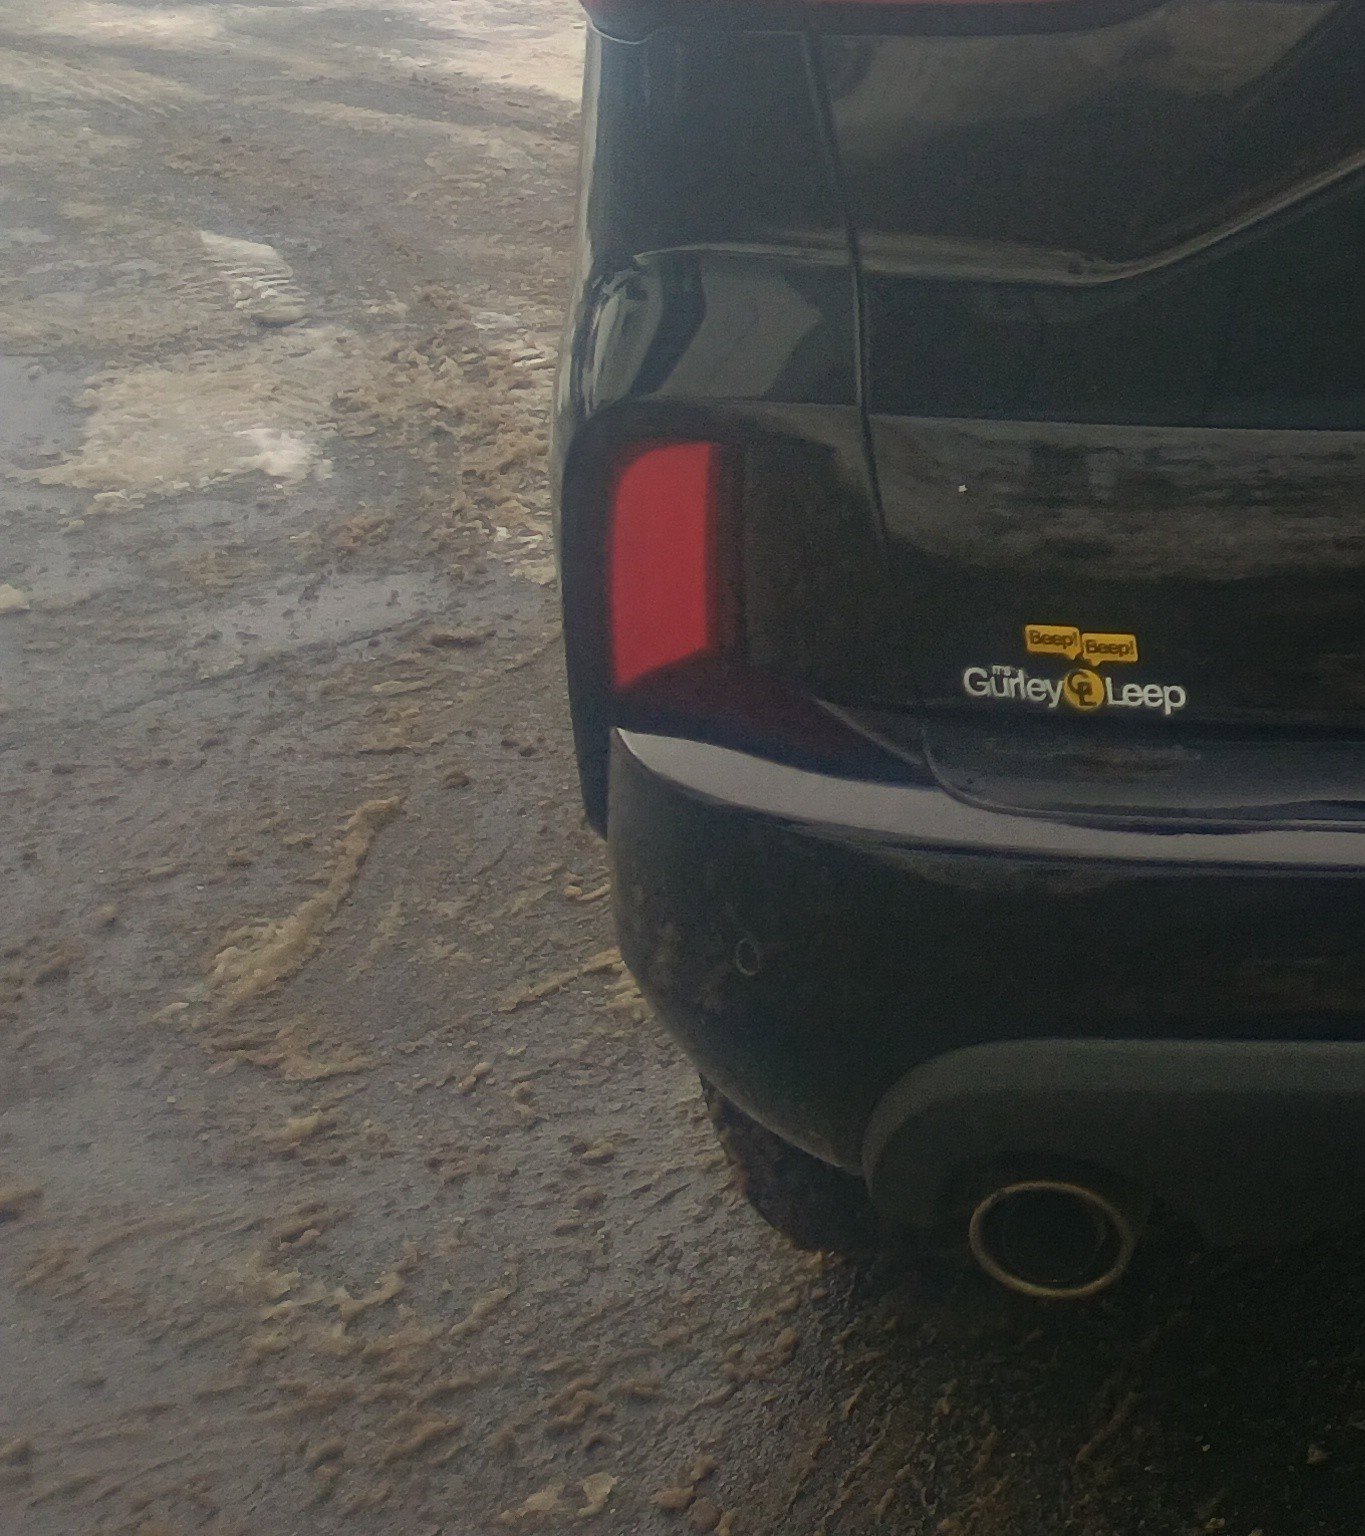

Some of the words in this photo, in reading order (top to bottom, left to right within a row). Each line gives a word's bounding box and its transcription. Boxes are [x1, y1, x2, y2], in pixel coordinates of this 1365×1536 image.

[1028, 629, 1078, 648] Beep!
[1085, 639, 1134, 657] Beep!
[962, 666, 1065, 708] Gurley
[1105, 676, 1187, 715] Leep
